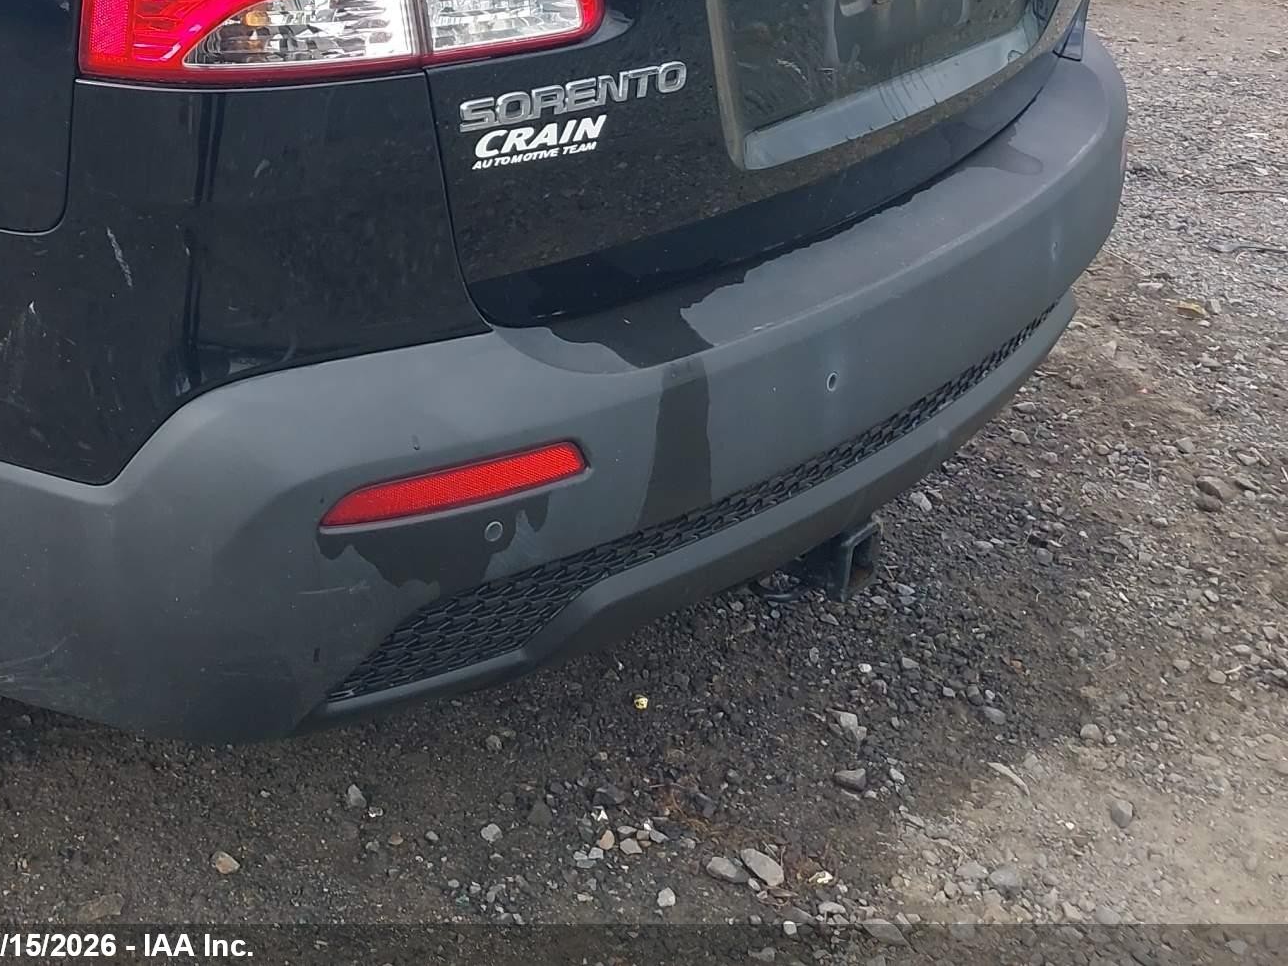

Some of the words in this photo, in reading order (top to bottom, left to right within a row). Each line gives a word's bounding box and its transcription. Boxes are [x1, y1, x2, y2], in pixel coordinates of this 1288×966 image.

[460, 61, 687, 132] SORENTO
[472, 148, 559, 170] AUTOMOTIVE
[562, 141, 597, 155] TEAM
[475, 115, 607, 159] CRAIN
